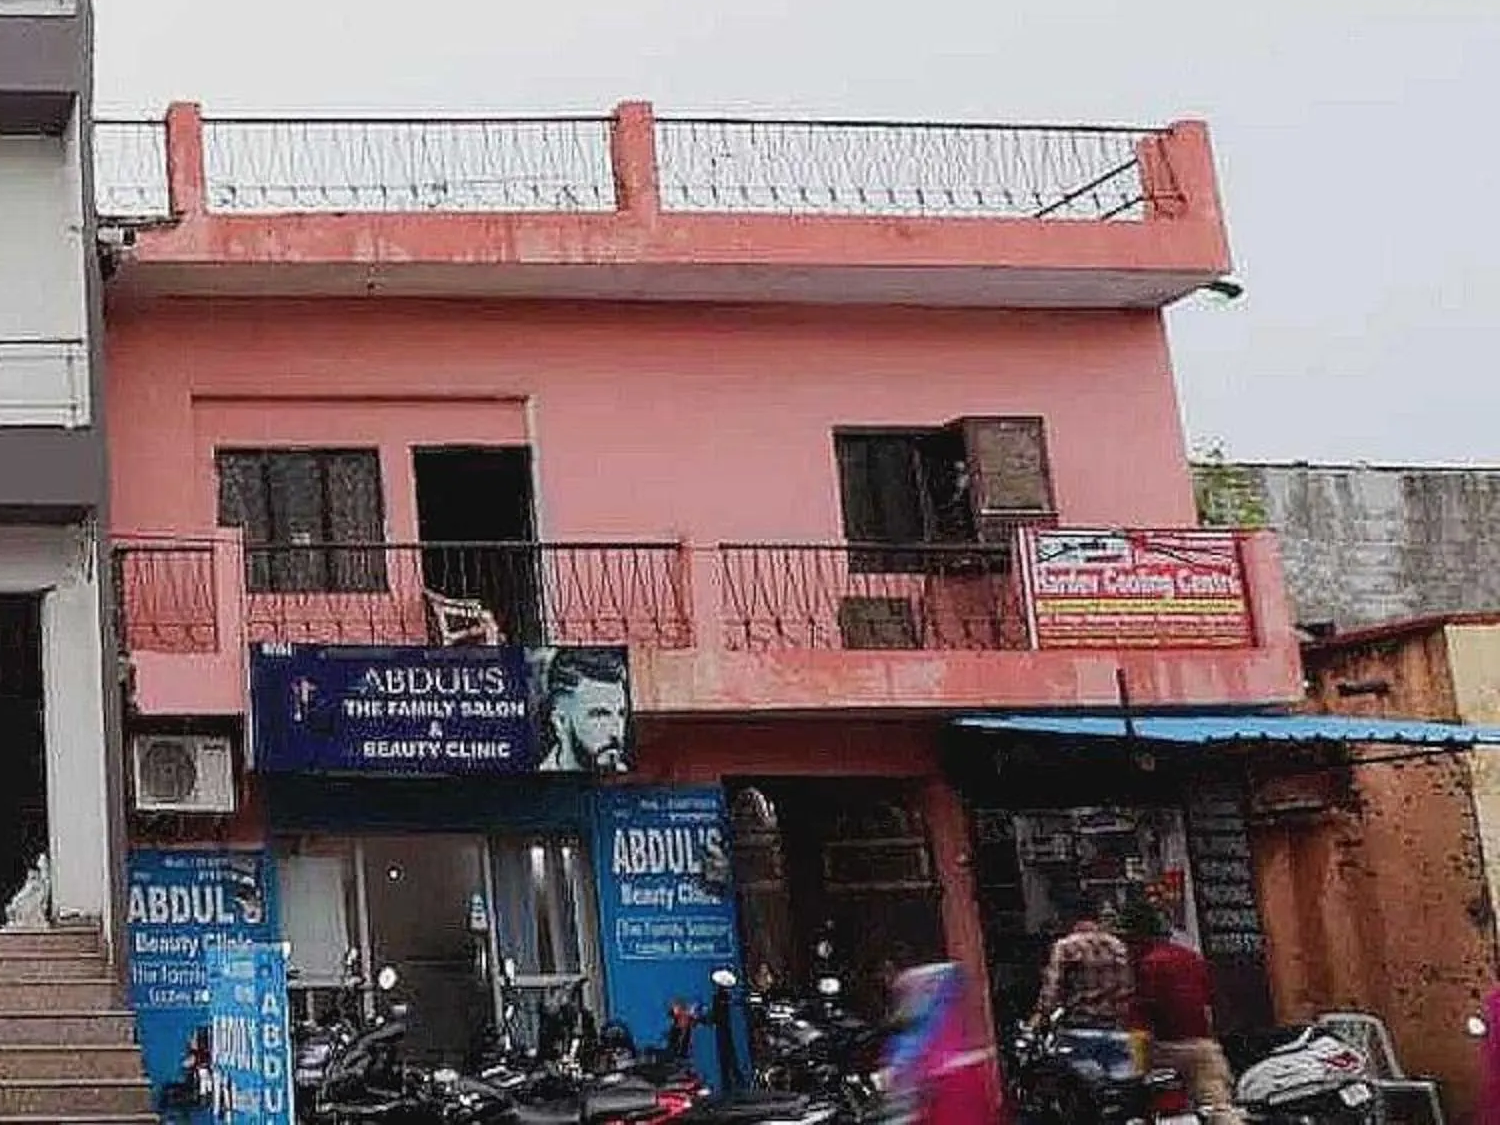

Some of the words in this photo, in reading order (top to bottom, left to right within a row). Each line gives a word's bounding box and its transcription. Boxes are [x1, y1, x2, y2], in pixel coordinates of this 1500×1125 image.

[345, 700, 385, 717] THE
[386, 700, 453, 718] FAMILY
[459, 700, 525, 717] SALON
[428, 720, 444, 738] &
[362, 740, 441, 759] BEAUTY
[445, 740, 511, 759] CLINIC
[135, 931, 199, 959] Beauty
